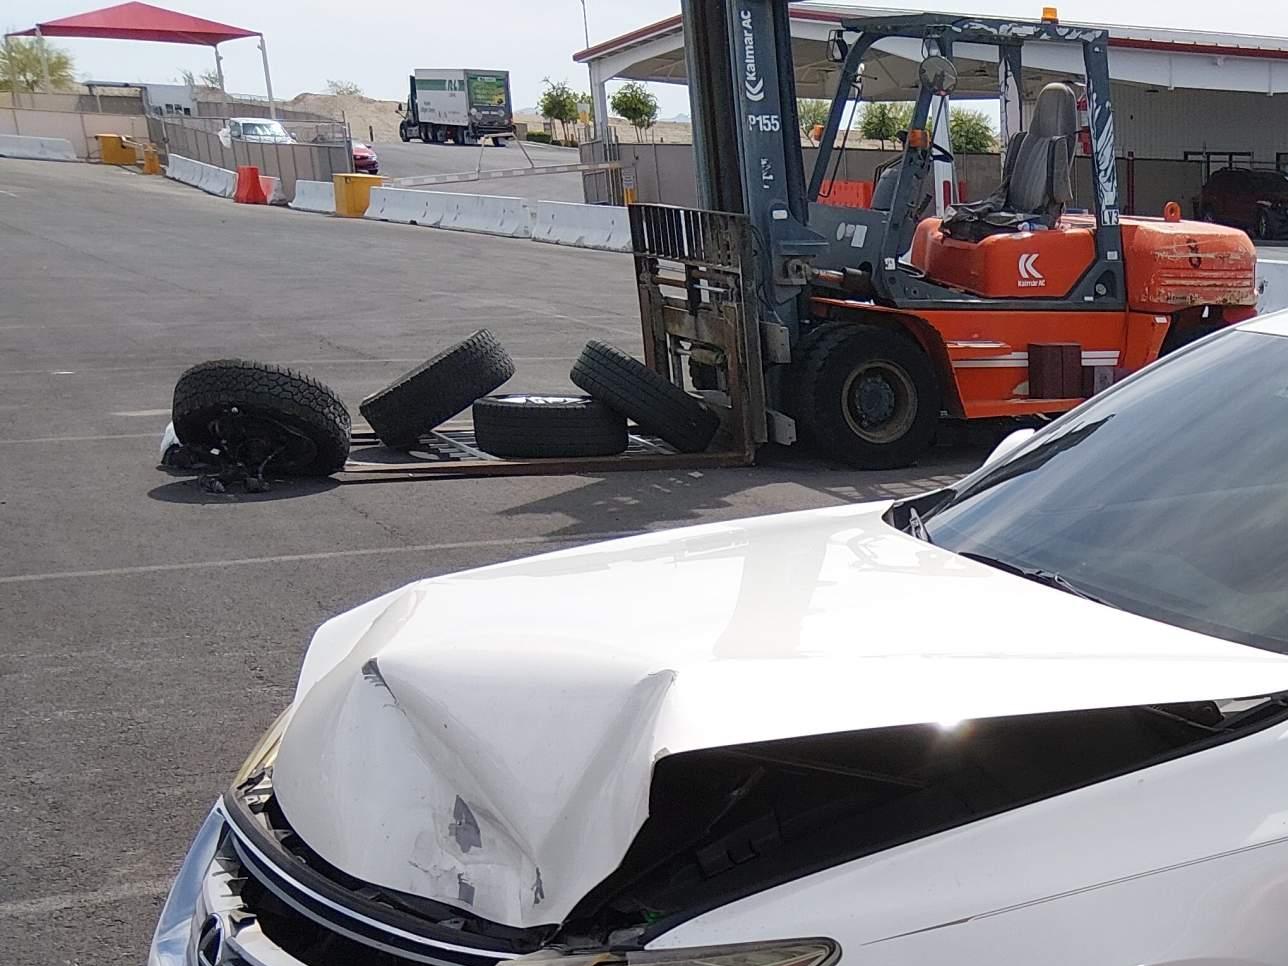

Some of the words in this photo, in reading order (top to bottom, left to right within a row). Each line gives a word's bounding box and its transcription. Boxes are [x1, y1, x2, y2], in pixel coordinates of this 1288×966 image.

[740, 10, 752, 30] AC
[743, 30, 756, 81] Kalmar
[748, 115, 780, 132] P155
